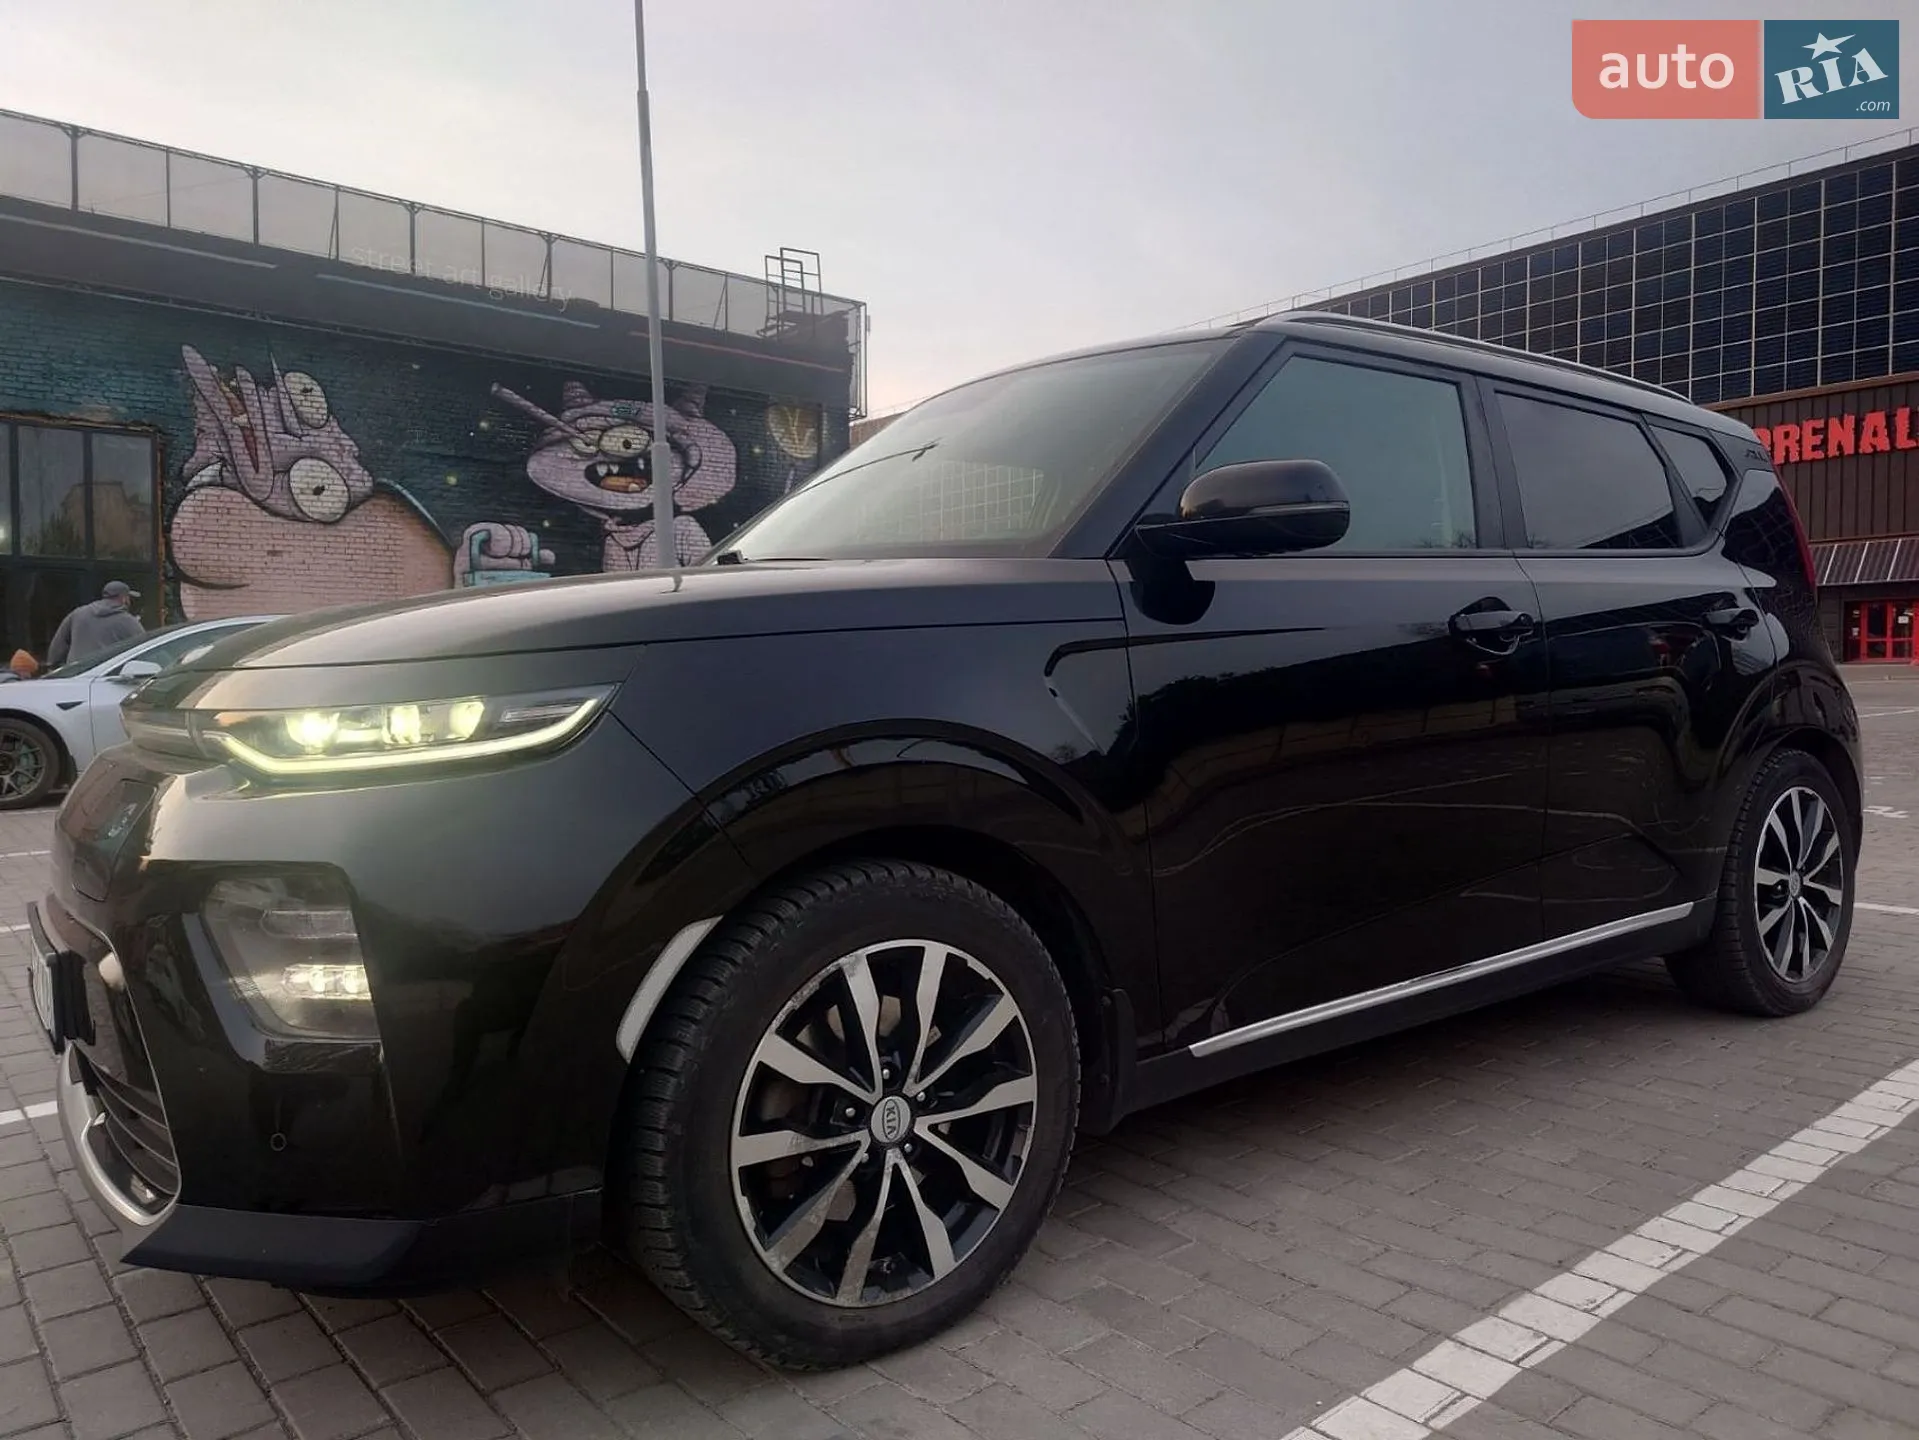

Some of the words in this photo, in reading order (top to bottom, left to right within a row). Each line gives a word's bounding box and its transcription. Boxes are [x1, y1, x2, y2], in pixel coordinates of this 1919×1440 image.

[443, 263, 481, 290] art
[1752, 407, 1919, 465] RENAL
[885, 1105, 897, 1135] KIA
